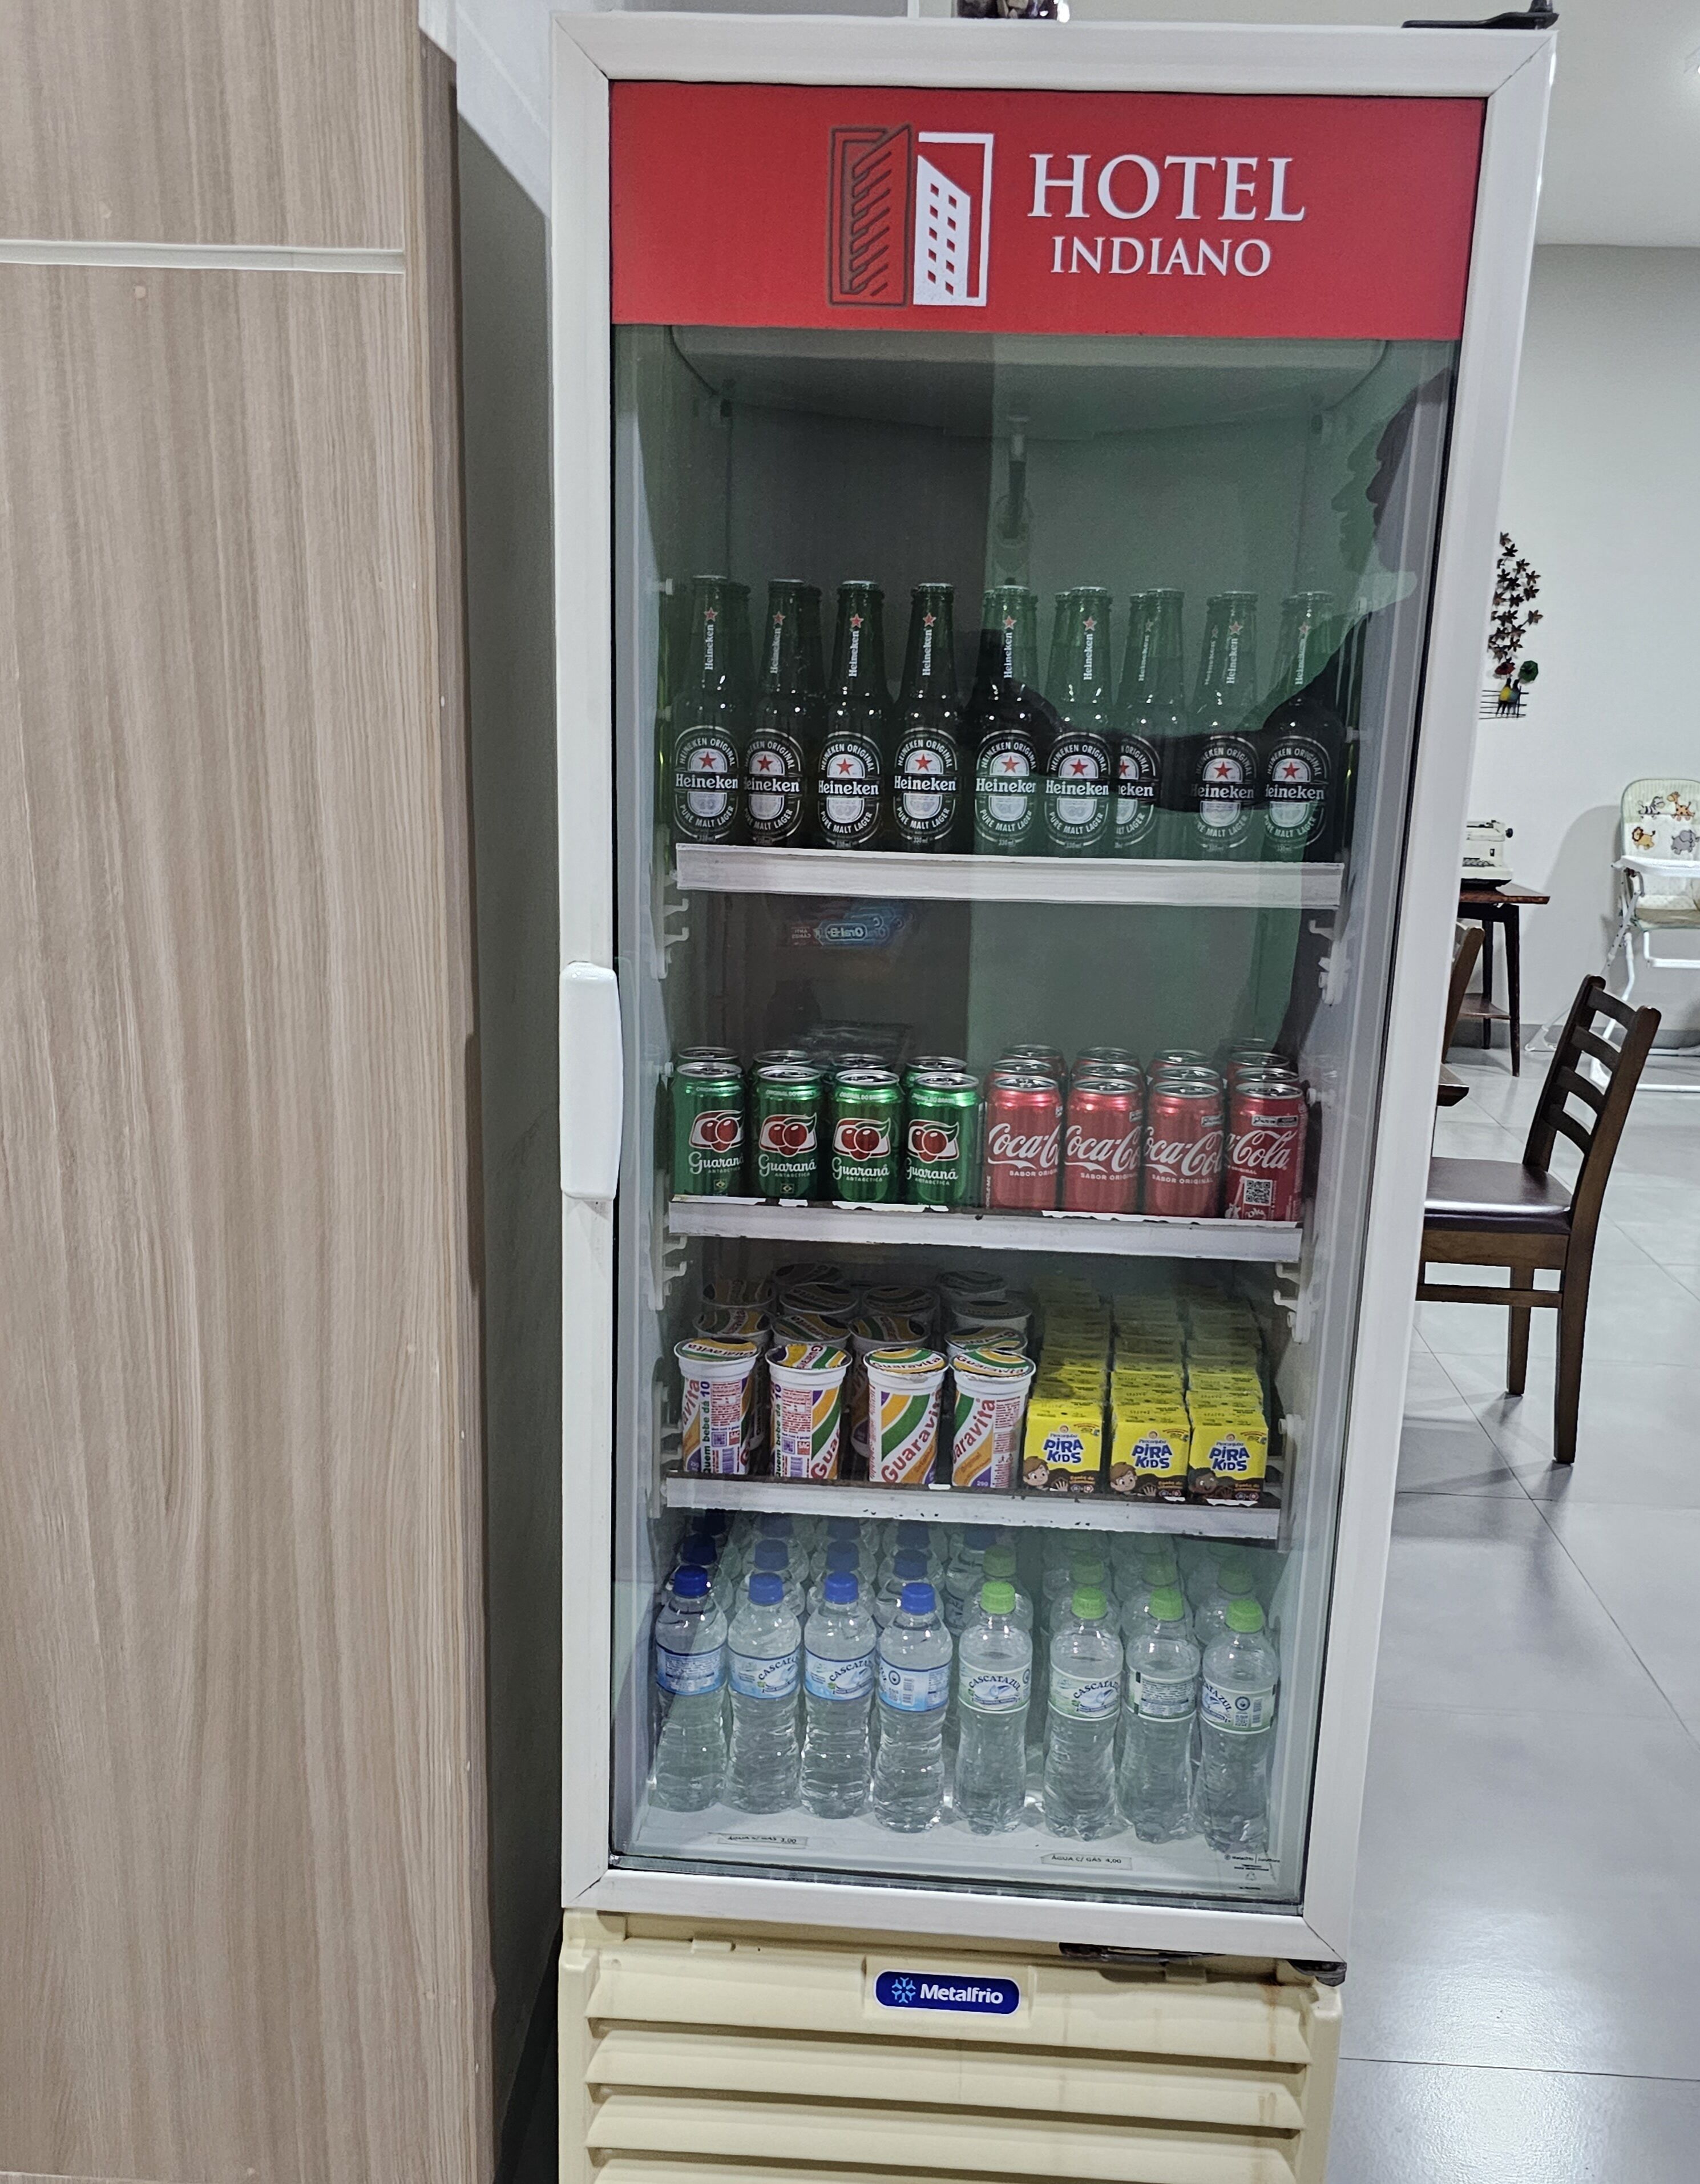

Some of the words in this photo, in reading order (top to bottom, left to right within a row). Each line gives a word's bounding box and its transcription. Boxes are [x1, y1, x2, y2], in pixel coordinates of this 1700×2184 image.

[1027, 154, 1305, 222] HOTEL
[1050, 236, 1271, 277] INDIANO
[705, 624, 713, 671] Heineken
[849, 629, 860, 677] Heineken
[922, 629, 932, 676] Heineken
[1003, 631, 1012, 679] Heineken
[1084, 633, 1093, 681] Heineken
[1226, 637, 1238, 684] Heineken
[710, 738, 735, 766] ORIGINAL
[768, 741, 795, 769] ORIGINAL
[821, 744, 845, 771] HEINEKEN
[847, 744, 875, 772] ORIGINAL
[898, 740, 923, 766] HEINEKEN
[926, 740, 953, 768] ORIGINAL
[981, 742, 1011, 768] HEINEKEN
[1013, 742, 1036, 770] ORIGINAL
[1051, 744, 1079, 771] HEINEKEN
[1082, 744, 1106, 773] ORIGINAL
[1125, 745, 1149, 773] ORIGINAL
[1227, 748, 1253, 776] ORIGINAL
[1294, 748, 1322, 776] ORIGINAL
[675, 773, 738, 789] Heineken
[818, 780, 879, 795] Heineken
[894, 775, 956, 791] Heineken
[1045, 780, 1109, 796] Heineken
[680, 805, 693, 823] PURE
[695, 818, 714, 828] MALT
[717, 805, 734, 826] LAGER
[755, 822, 771, 830] MALT
[773, 809, 793, 829] LAGER
[821, 810, 830, 830] PURE
[833, 825, 851, 834] MALT
[854, 812, 873, 832] LAGER
[897, 807, 907, 825] PURE
[910, 821, 929, 830] MALT
[931, 808, 950, 827] LAGER
[980, 809, 994, 827] PURE
[995, 819, 1015, 831] MALT
[1017, 810, 1032, 830] LAGER
[1049, 812, 1061, 830] PURE
[1063, 823, 1084, 834] MALT
[1086, 812, 1104, 832] LAGER
[1126, 812, 1145, 834] LAGER
[1206, 829, 1225, 837] MALT
[1229, 815, 1248, 835] LAGER
[1297, 817, 1317, 834] LAGER
[758, 1153, 817, 1177] Guaraná
[832, 1157, 890, 1180] Guaraná
[1152, 1174, 1177, 1183] SABOR
[873, 1356, 941, 1369] Guaravita
[956, 1355, 1024, 1374] Guaravita
[700, 1380, 710, 1397] 10
[774, 1384, 781, 1400] 10
[954, 1399, 995, 1464] aravita
[968, 1676, 1021, 1691] CASCATAZUL
[920, 1984, 1003, 2004] Metalfrio
